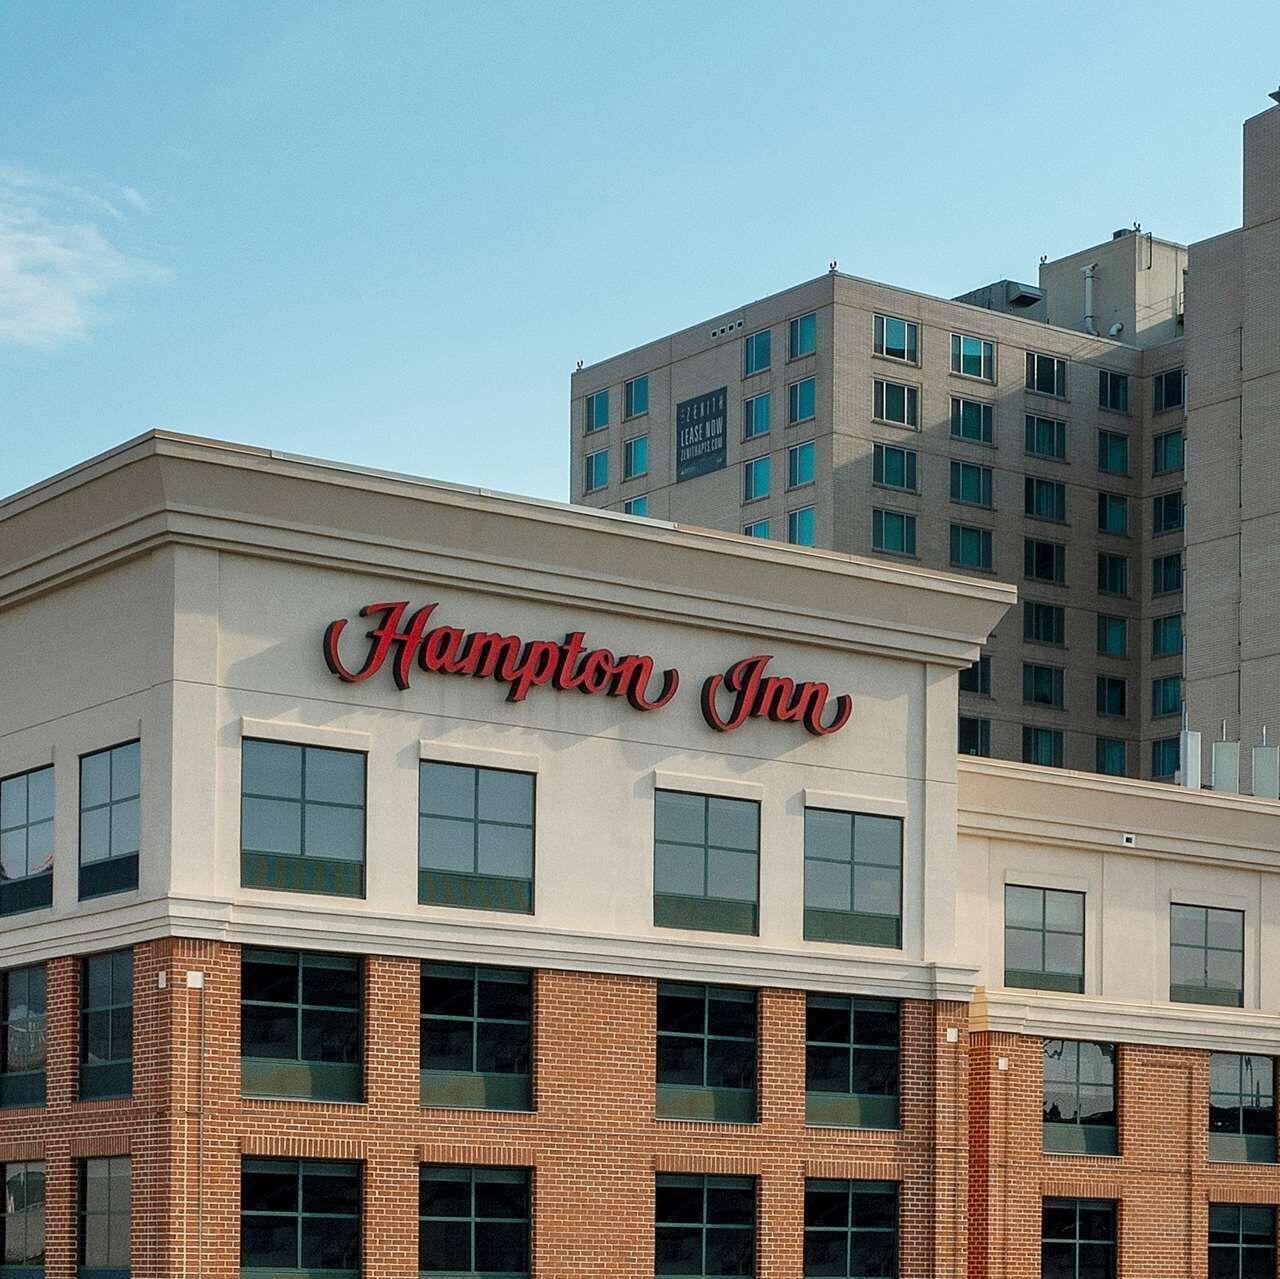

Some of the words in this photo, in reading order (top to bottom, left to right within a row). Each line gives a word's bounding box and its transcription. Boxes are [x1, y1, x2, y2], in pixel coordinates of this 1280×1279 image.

[681, 423, 703, 447] LEASE
[705, 415, 724, 438] NOW
[323, 600, 679, 711] Hampton
[700, 654, 853, 736] Inn
